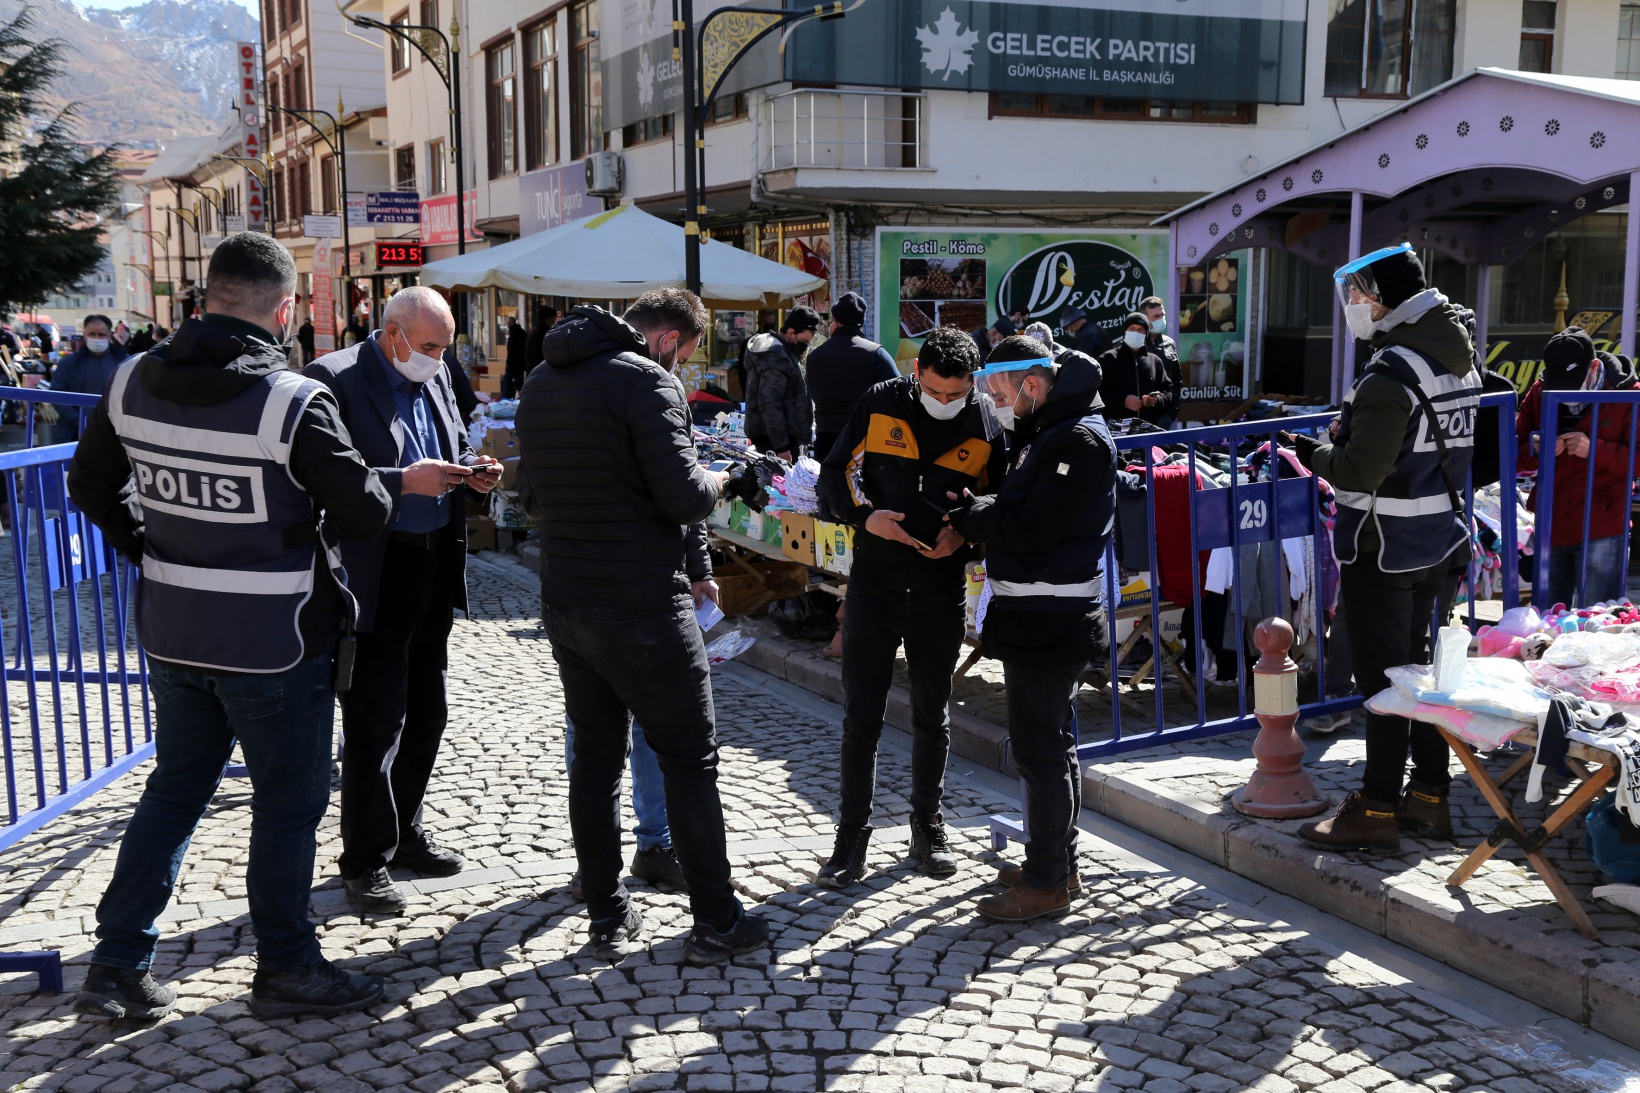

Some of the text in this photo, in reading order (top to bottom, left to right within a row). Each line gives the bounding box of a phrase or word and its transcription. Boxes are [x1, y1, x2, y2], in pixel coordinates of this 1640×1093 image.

[987, 31, 1196, 65] GELECEK PARTİSİ
[241, 46, 255, 106] OTEL
[656, 56, 683, 82] GELEC
[1007, 63, 1175, 85] GÜMÜŞHANE İL BAŞKANLIĞI
[663, 85, 684, 100] GÜMÜŞHA
[562, 189, 583, 215] sigorta
[381, 247, 406, 260] 213
[903, 240, 938, 255] Pestil
[949, 240, 985, 255] Köme
[1180, 385, 1242, 399] Günlük Süt
[135, 462, 242, 510] POLİS
[1239, 499, 1267, 530] 29
[1122, 591, 1152, 602] REMIUM
